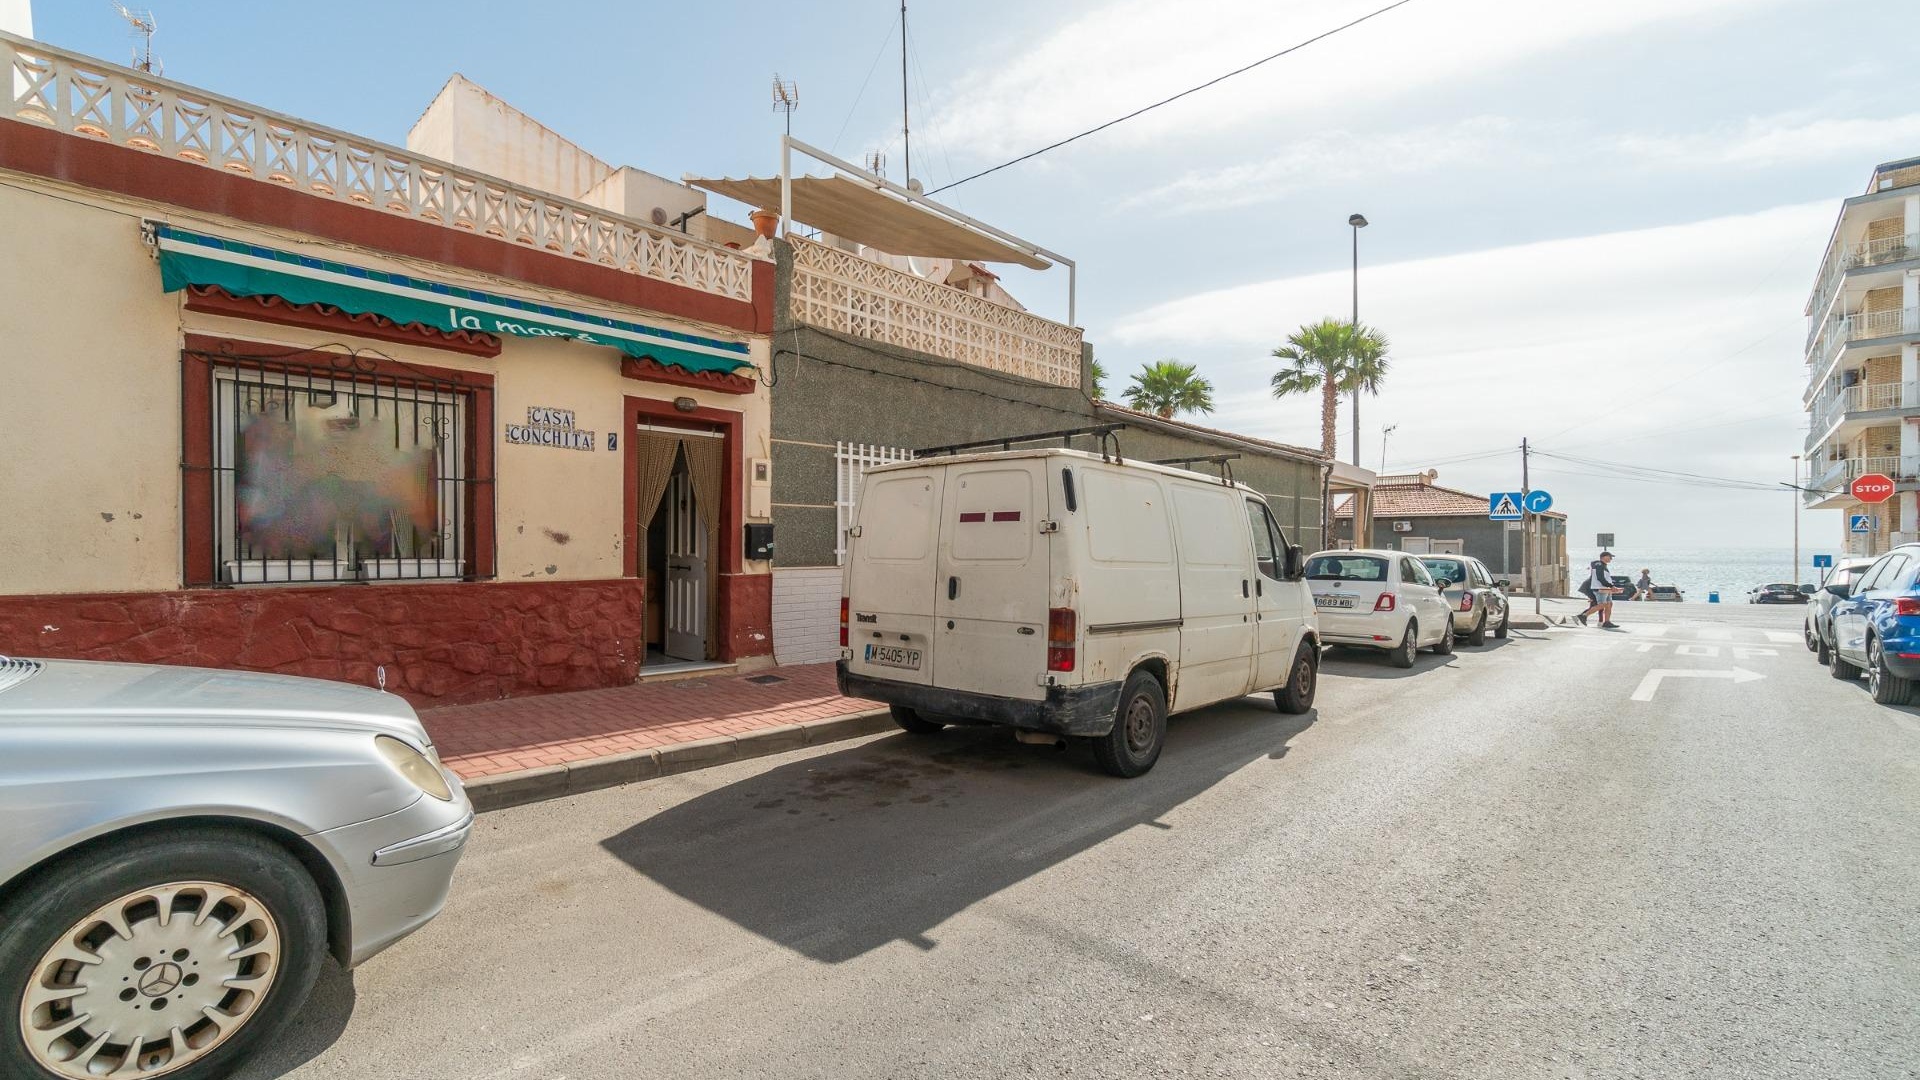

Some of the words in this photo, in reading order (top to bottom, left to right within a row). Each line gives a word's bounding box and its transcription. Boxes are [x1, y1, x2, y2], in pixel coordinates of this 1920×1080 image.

[450, 308, 482, 330] la
[532, 409, 571, 428] CASA
[510, 426, 591, 448] CONCHITA
[609, 434, 616, 450] 2
[1855, 484, 1890, 493] STOP
[856, 613, 877, 623] Transit
